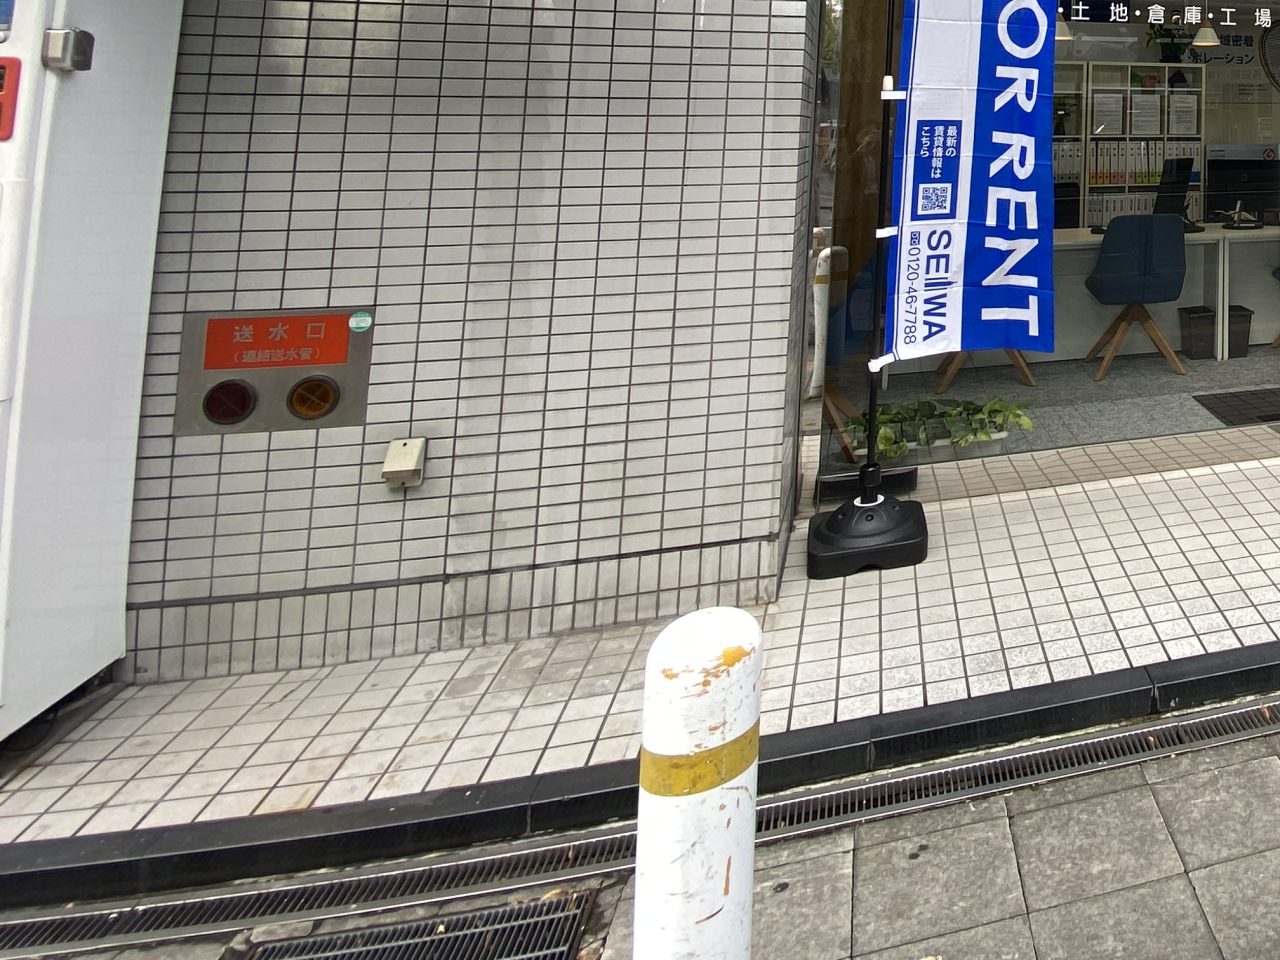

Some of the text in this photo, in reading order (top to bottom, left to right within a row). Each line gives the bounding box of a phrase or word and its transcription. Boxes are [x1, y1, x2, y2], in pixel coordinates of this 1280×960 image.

[920, 126, 931, 158] こちら
[931, 125, 944, 179] 賃貸情報は
[945, 125, 958, 157] 最新の
[981, 130, 1039, 336] RENT
[904, 247, 921, 345] 0120-46-7788
[233, 322, 325, 343] 送水口
